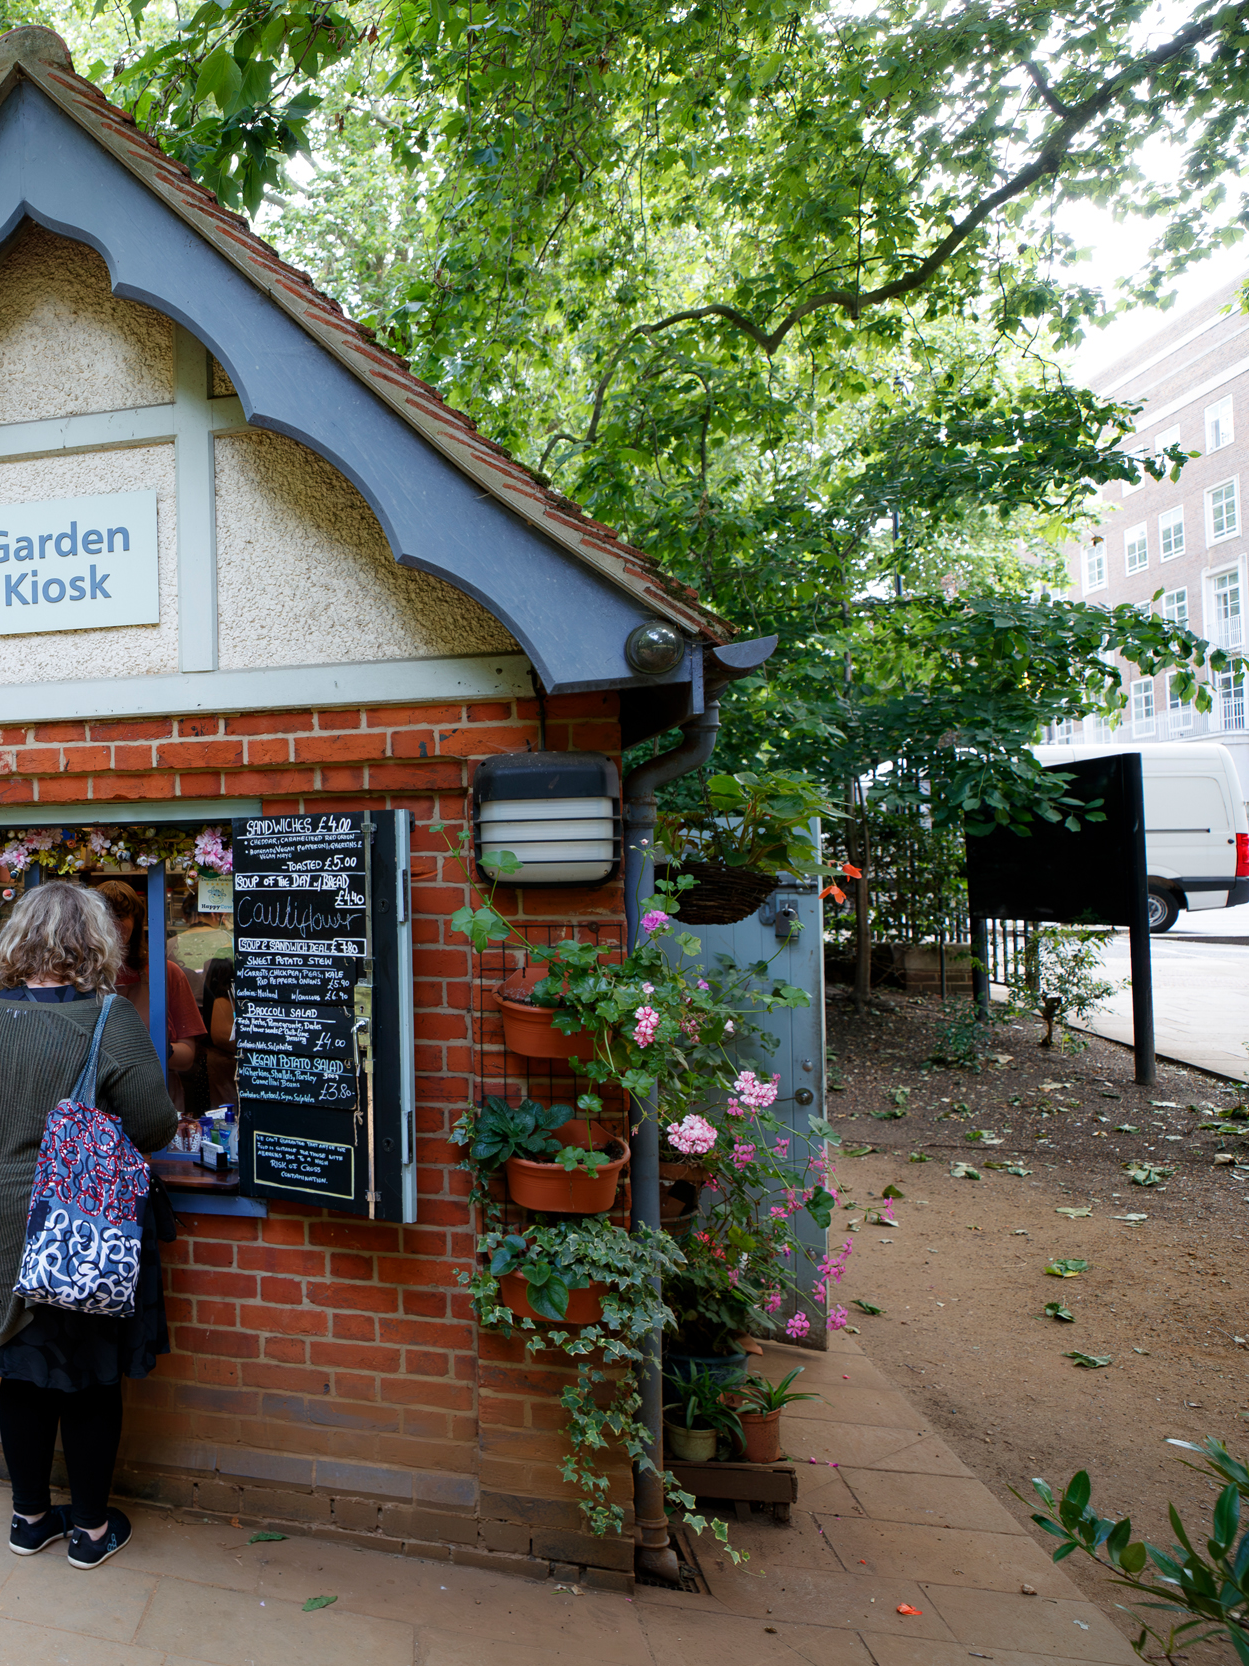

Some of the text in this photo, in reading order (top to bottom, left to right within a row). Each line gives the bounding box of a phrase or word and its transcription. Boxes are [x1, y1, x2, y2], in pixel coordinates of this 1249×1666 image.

[5, 564, 112, 606] Kiosk
[246, 815, 351, 836] SANDWICHES £4.00
[324, 855, 357, 870] £5.00
[237, 876, 259, 888] SOUP
[277, 876, 289, 887] THE
[291, 874, 310, 888] DAY
[322, 874, 349, 888] BREAD
[241, 941, 260, 949] SOUP
[270, 943, 308, 952] SANDWICH
[310, 944, 328, 953] DEAL
[247, 956, 272, 965] SWEET
[276, 956, 303, 965] POTATO
[248, 1003, 317, 1018] BROCCOLI SALAD
[248, 1053, 343, 1073] VEGAN POTATO SALAD
[270, 1159, 286, 1169] RISK
